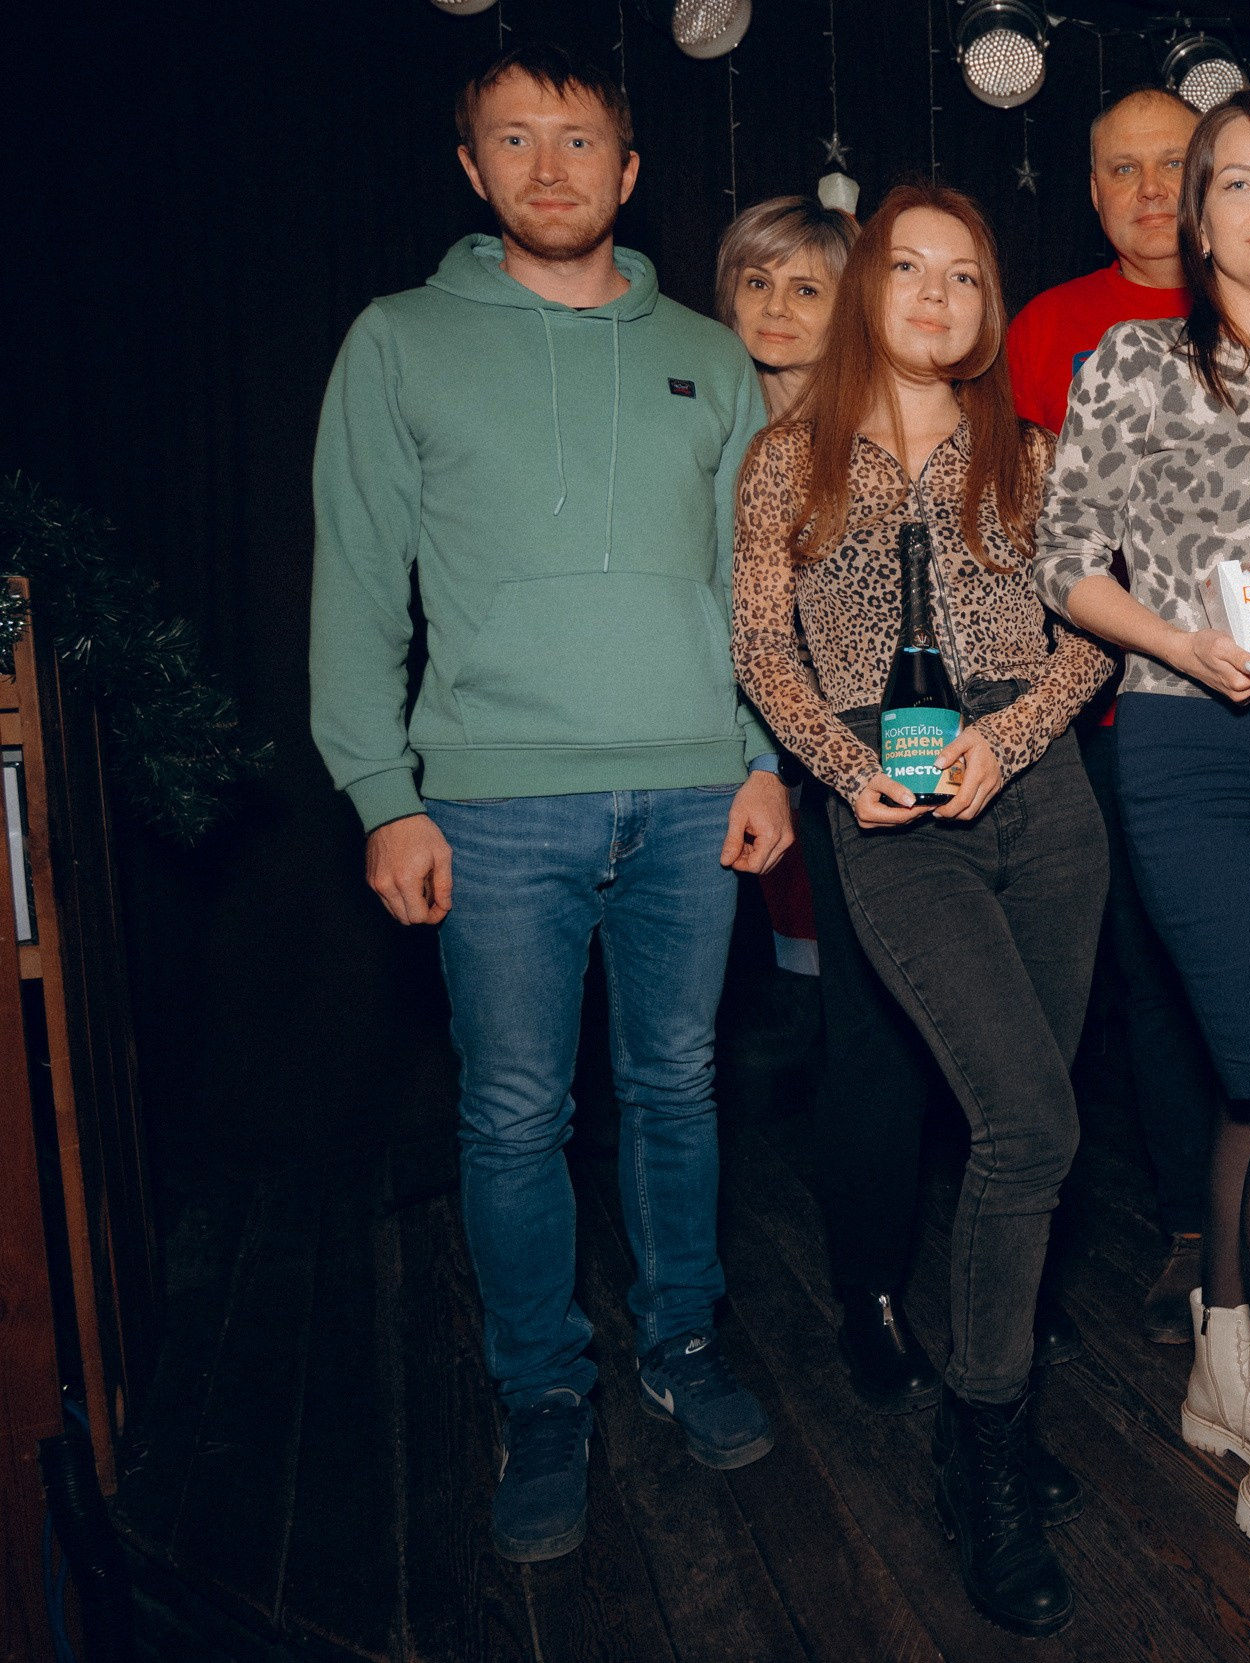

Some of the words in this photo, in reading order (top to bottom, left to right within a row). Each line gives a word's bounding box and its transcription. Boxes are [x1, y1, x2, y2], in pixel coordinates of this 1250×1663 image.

[885, 724, 943, 738] КОКТЕЙЛЬ
[885, 766, 892, 778] 2
[895, 765, 942, 777] место
